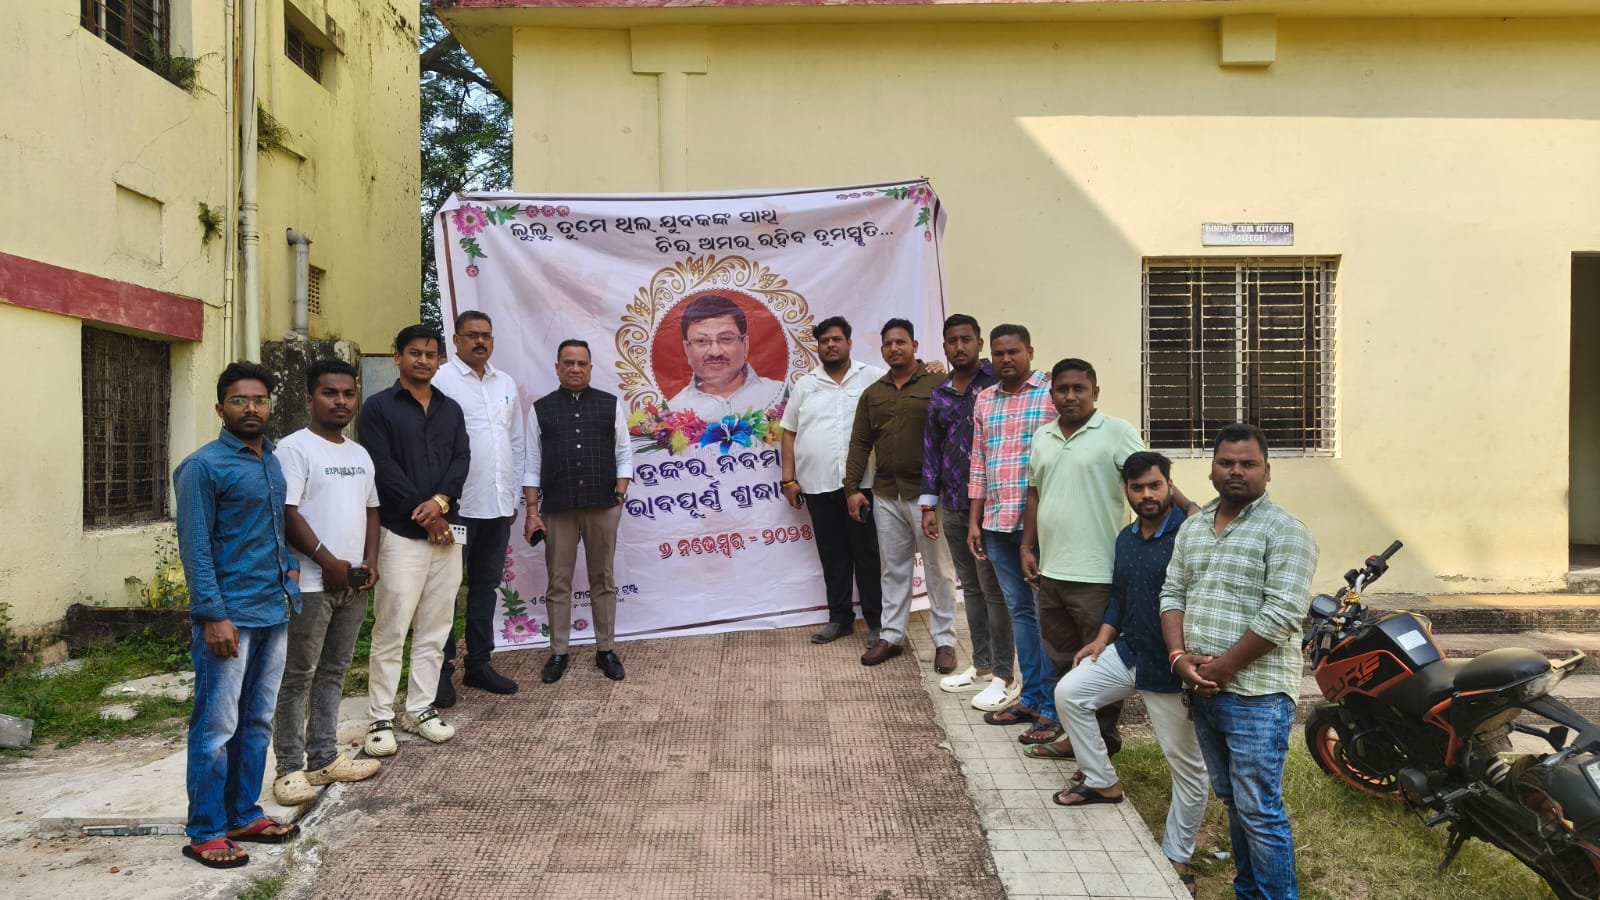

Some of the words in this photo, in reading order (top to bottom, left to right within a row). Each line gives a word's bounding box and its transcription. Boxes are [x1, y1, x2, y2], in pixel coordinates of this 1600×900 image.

[510, 223, 553, 241] ଲୁଲୁ
[556, 219, 608, 240] ତୁମେ
[615, 217, 656, 234] ଥିଲ
[660, 213, 731, 233] ଯୁବକଙ୍କ
[739, 210, 779, 224] ସାଥି
[1205, 225, 1234, 233] DINING
[1236, 225, 1255, 233] CUM
[1256, 224, 1289, 233] KITCHEN
[655, 236, 696, 255] ଚିର
[698, 235, 755, 251] ଅମର
[757, 228, 806, 249] ରହିବ
[731, 481, 786, 508] ଶ୍ରଦ୍ଧା
[762, 525, 813, 545] ୨୦୨୫
